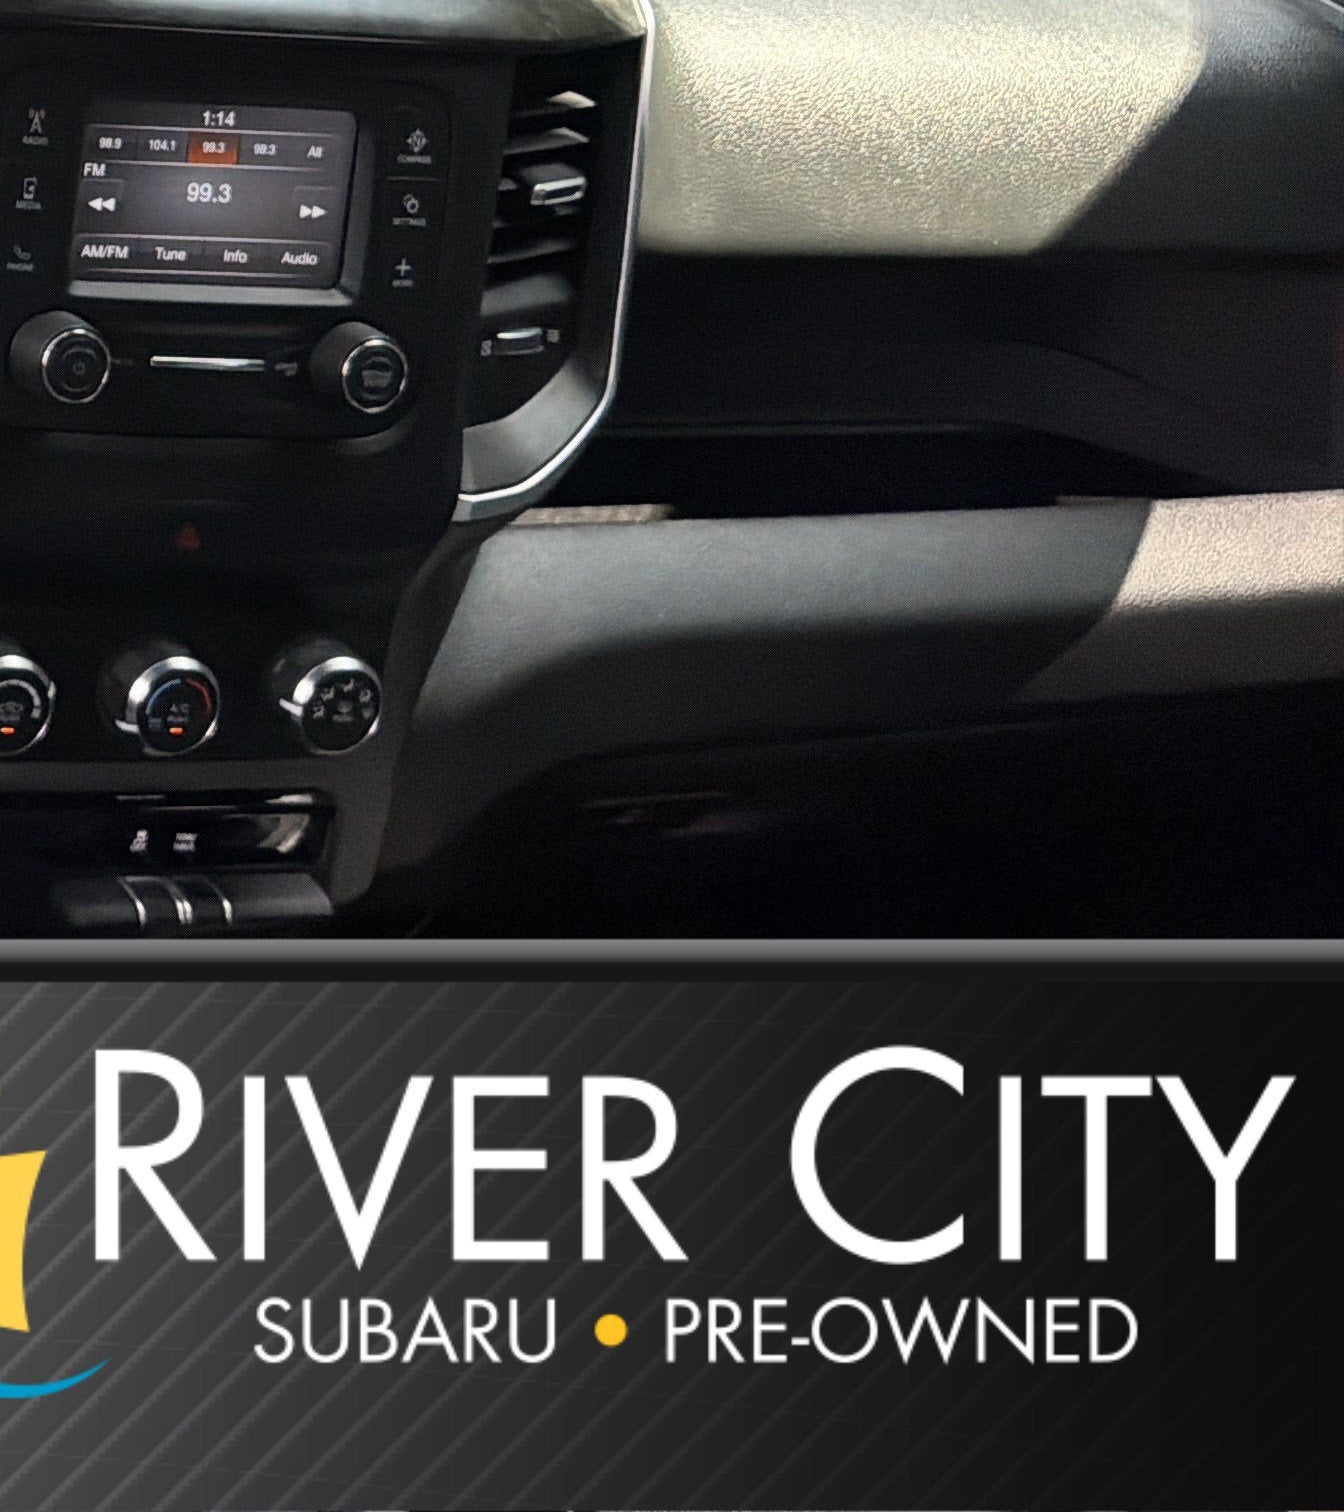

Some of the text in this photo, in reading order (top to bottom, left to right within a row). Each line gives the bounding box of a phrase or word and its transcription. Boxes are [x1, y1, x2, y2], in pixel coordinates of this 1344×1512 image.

[202, 110, 236, 127] 1:14
[83, 162, 106, 177] FM
[185, 182, 232, 204] 99.3
[80, 243, 318, 267] AM/FM Tune Info Audio
